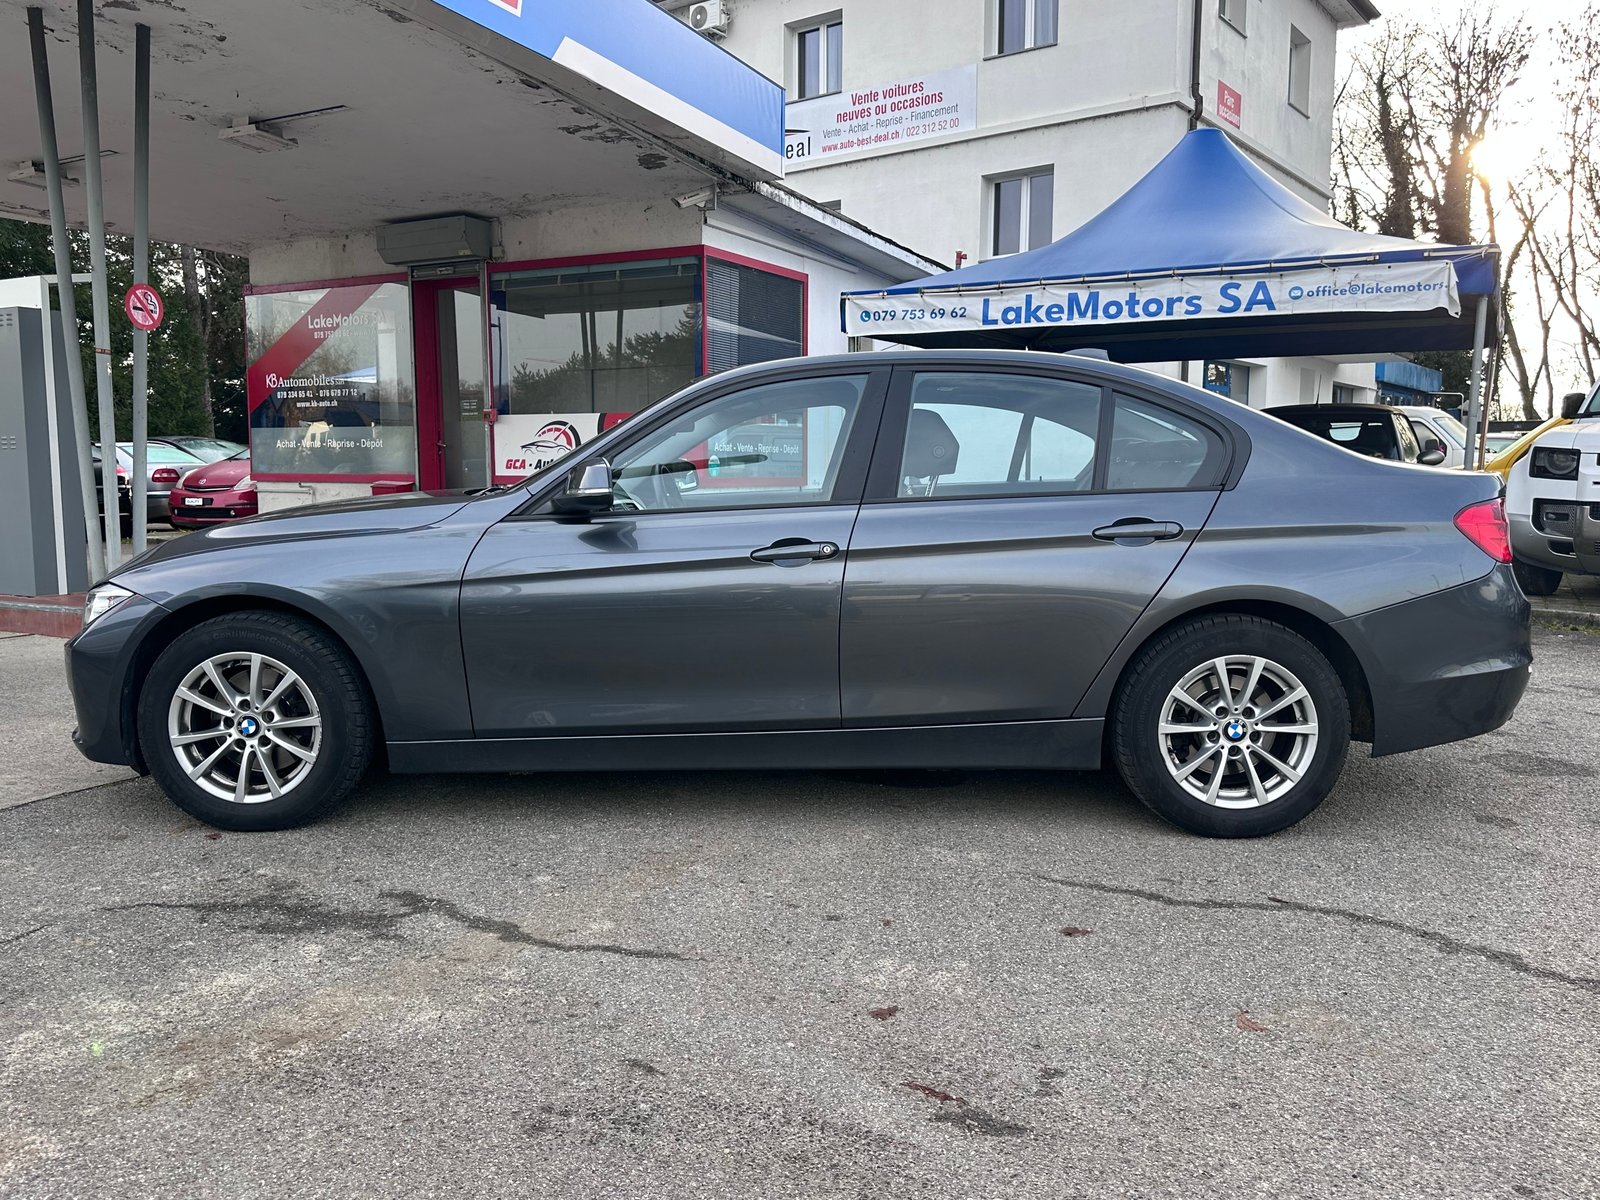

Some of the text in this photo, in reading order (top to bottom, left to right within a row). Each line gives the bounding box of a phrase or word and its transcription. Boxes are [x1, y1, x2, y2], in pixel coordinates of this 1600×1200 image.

[850, 81, 924, 106] Vente voitures
[836, 92, 944, 124] neuves ou occasions
[822, 126, 842, 139] Vente
[848, 122, 869, 134] Achat
[876, 116, 903, 130] Reprise
[910, 104, 959, 122] Financement
[822, 130, 900, 153] www.auto-best-deal.ch
[906, 126, 920, 137] 022
[922, 123, 936, 135] 312
[938, 120, 948, 131] 52
[949, 118, 960, 128] 00
[785, 136, 811, 160] eal
[873, 306, 967, 321] 079 753 69 62
[982, 280, 1276, 326] LakeMotors SA
[308, 312, 369, 328] LakeMotors
[276, 439, 296, 448] Achat
[302, 439, 321, 448] Vente
[327, 439, 354, 450] Reprise
[361, 438, 383, 449] Dépôt
[714, 442, 732, 452] Achat
[737, 443, 753, 452] Vente
[758, 444, 779, 454] Reprise
[505, 459, 526, 469] GCA
